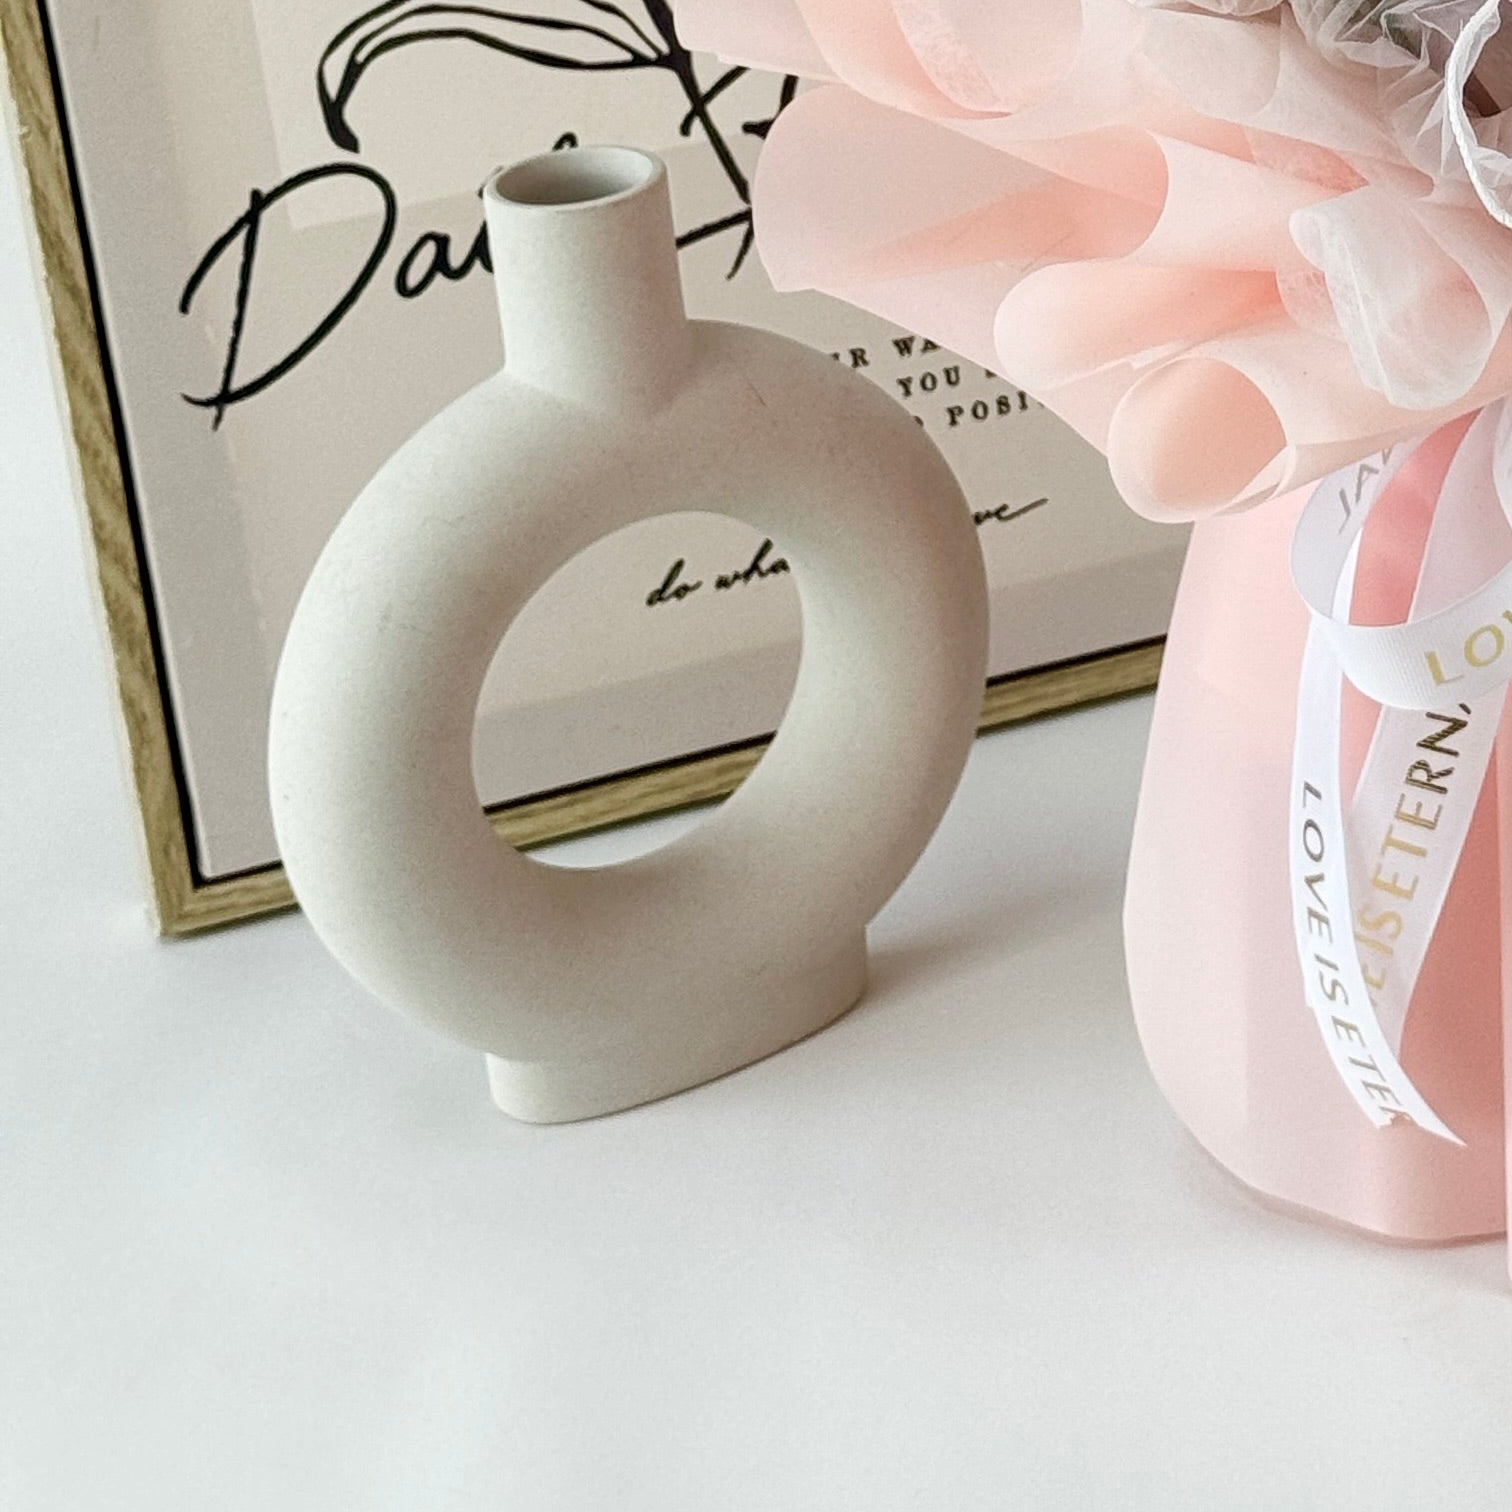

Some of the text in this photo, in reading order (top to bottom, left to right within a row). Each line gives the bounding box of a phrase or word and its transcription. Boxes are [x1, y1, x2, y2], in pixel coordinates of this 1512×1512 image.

[897, 365, 960, 397] YOU
[947, 390, 1044, 427] POSI
[646, 557, 703, 608] do
[714, 538, 791, 590] wha
[1370, 702, 1472, 901] ETERN
[1302, 779, 1334, 944] LOVE
